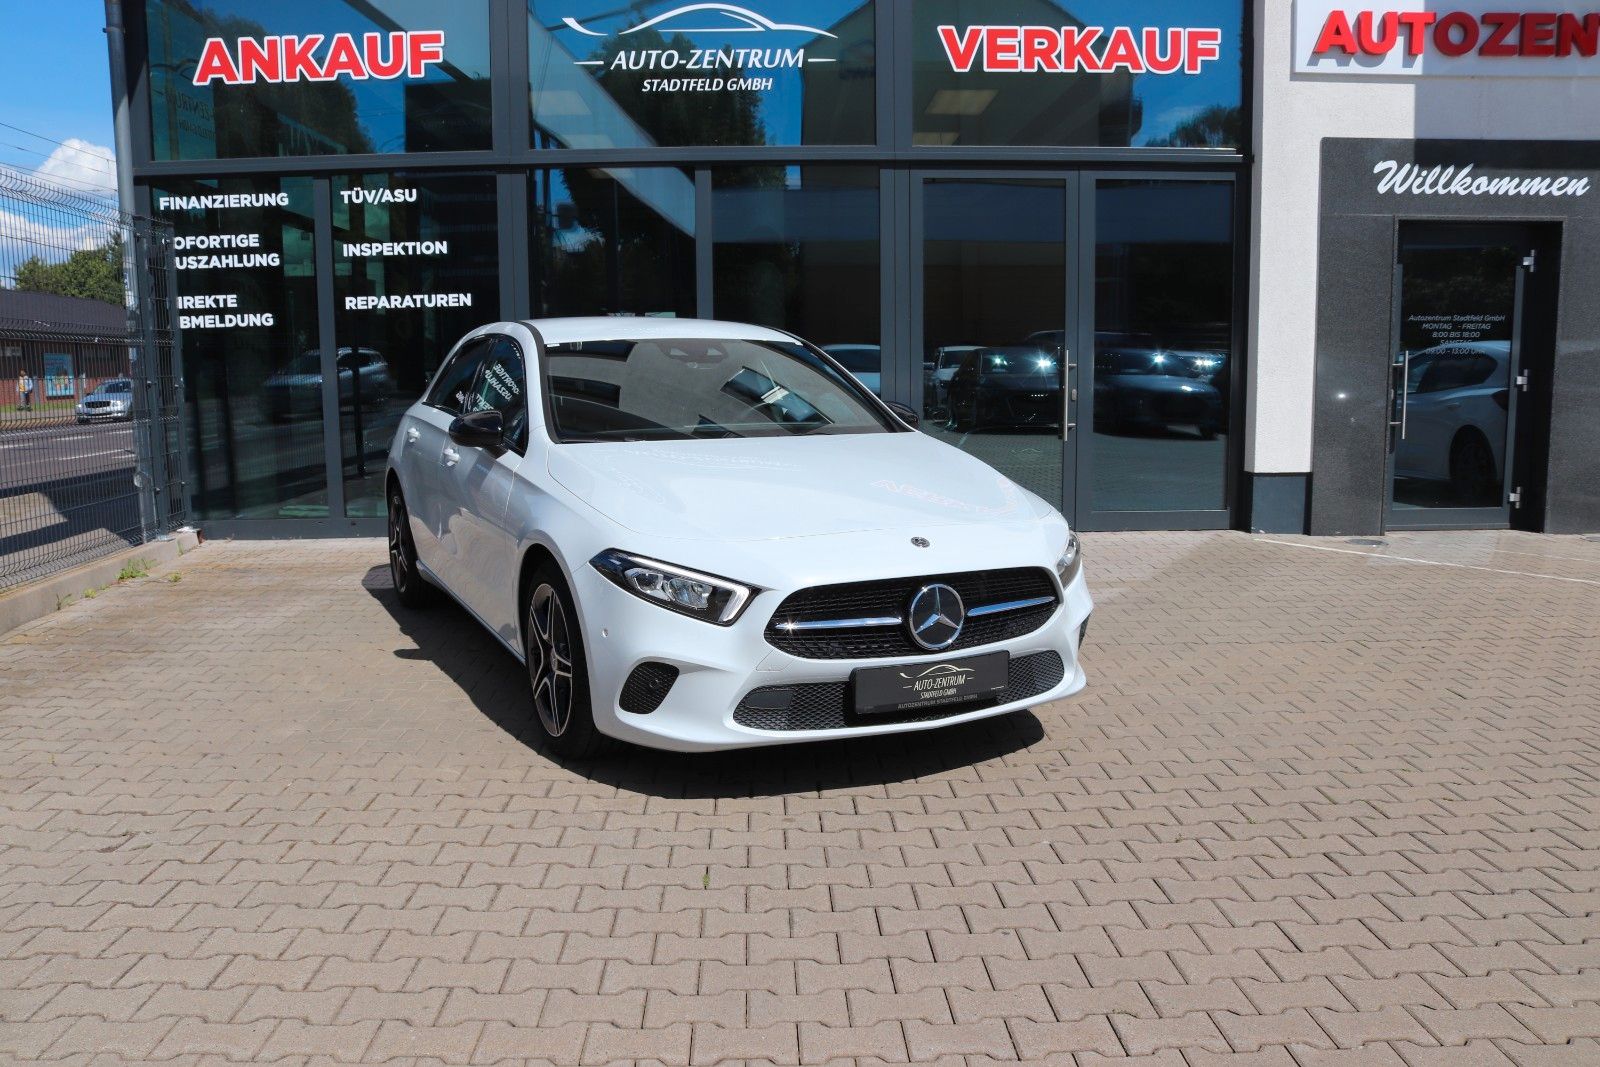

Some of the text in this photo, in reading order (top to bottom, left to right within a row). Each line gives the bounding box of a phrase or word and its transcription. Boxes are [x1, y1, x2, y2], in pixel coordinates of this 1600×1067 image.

[1312, 10, 1600, 57] AUTOZEN
[193, 31, 444, 85] ANKAUF
[937, 25, 1221, 74] VERKAUF
[610, 48, 805, 70] AUTO-ZENTRUM
[642, 78, 773, 92] STADTFELD GMBH
[1373, 160, 1591, 197] Willkommen
[159, 193, 289, 210] FINANZIERUNG
[341, 187, 417, 205] TÜV/ASU
[162, 234, 260, 250] OFORTIGE
[343, 241, 448, 257] INSPEKTION
[175, 253, 280, 270] USZAHLUNG
[177, 294, 238, 309] IREKTE
[345, 293, 472, 310] REPARATUREN
[180, 313, 274, 329] BMELDUNG
[1408, 314, 1451, 322] Autozentrum
[914, 674, 965, 691] AUTO-ZENTRUM
